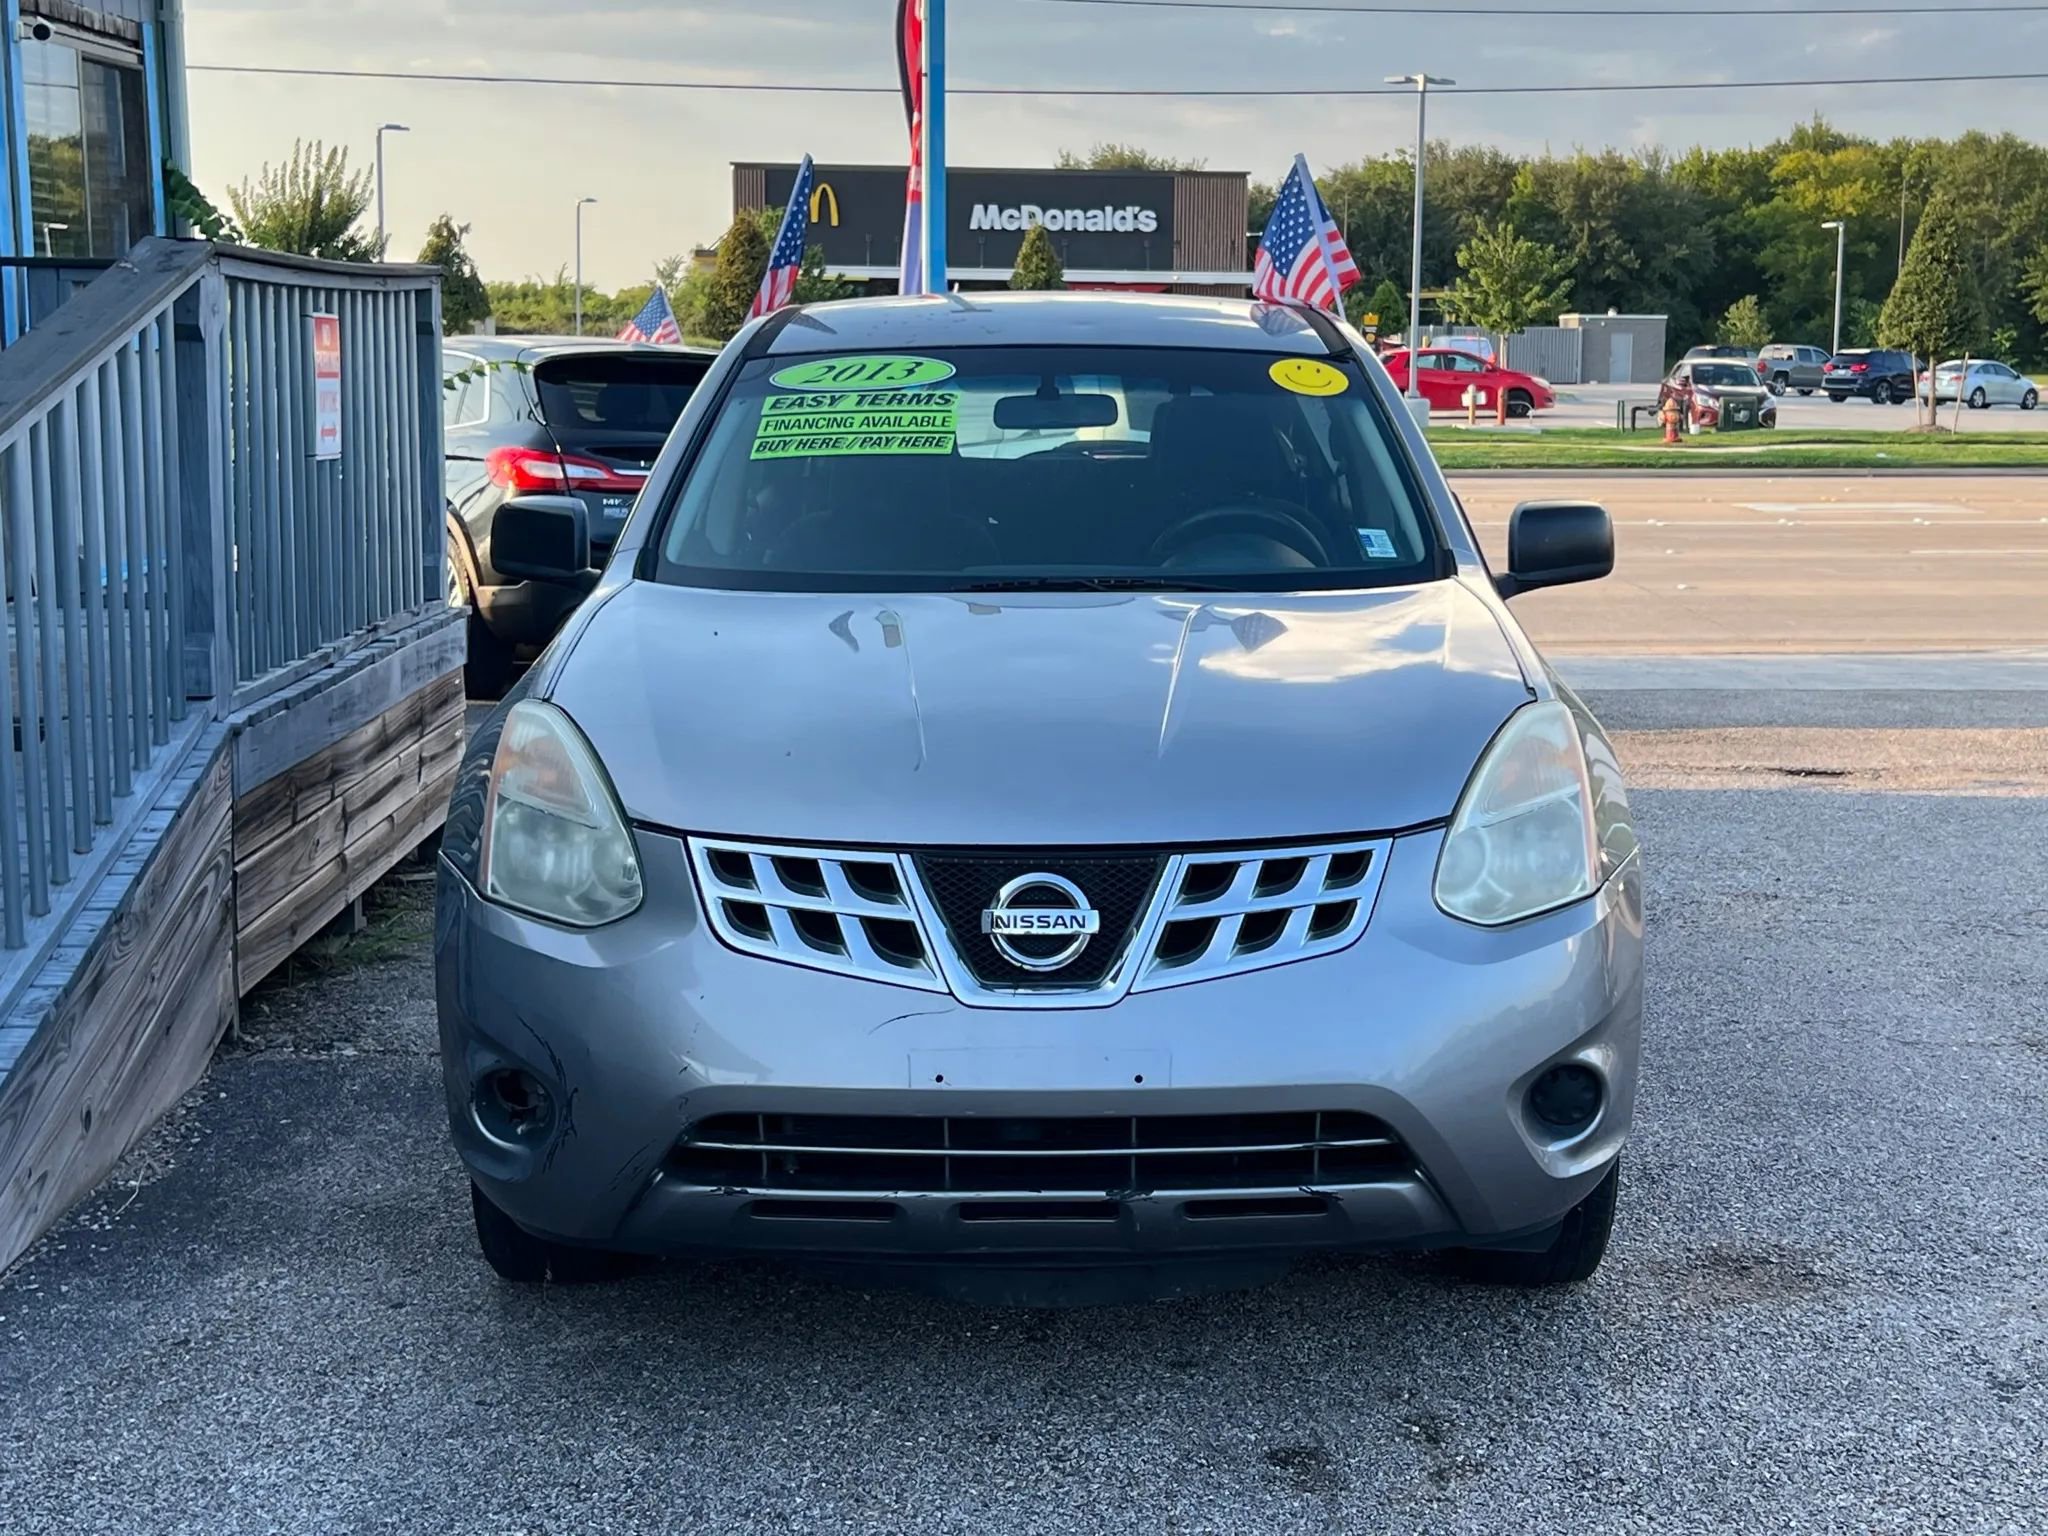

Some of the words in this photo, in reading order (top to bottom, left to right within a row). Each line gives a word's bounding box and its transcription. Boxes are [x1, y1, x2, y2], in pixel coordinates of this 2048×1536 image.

[969, 204, 1158, 232] McDonald's
[799, 360, 925, 385] 2013
[768, 393, 848, 411] EASY
[854, 391, 957, 408] TERMS
[763, 415, 855, 432] FINANCING
[858, 414, 953, 429] AVAILABLE
[755, 438, 794, 454] BUY
[898, 435, 951, 449] HERE
[995, 915, 1086, 929] NISSAN
